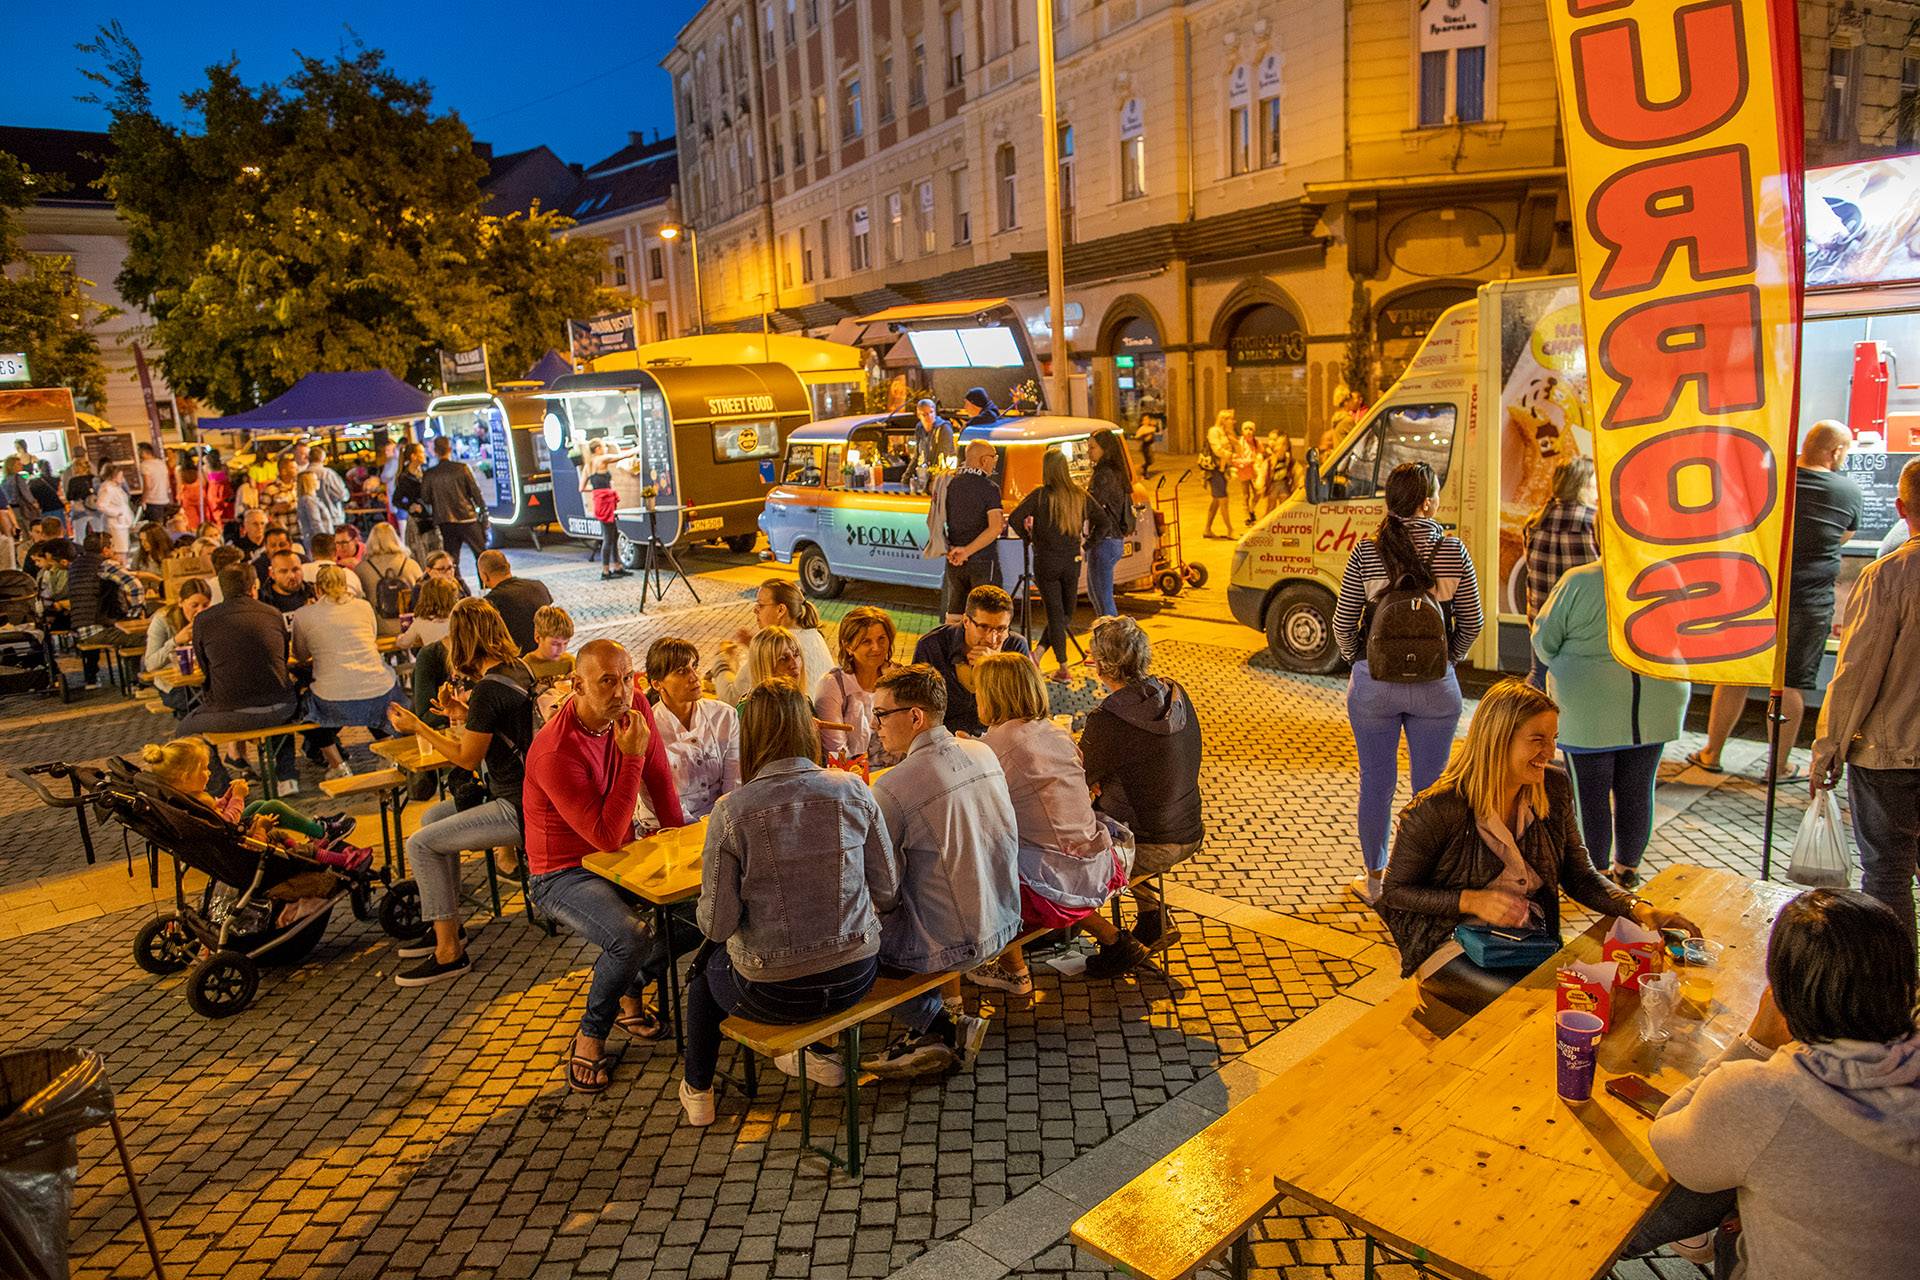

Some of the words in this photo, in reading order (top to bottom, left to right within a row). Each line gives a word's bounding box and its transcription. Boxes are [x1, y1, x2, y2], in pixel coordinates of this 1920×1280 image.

[708, 397, 746, 415] STREET
[747, 395, 774, 411] FOOD
[1319, 505, 1383, 515] CHURROS
[1271, 522, 1313, 535] churros
[857, 526, 919, 547] BORKA
[1260, 553, 1311, 563] churros
